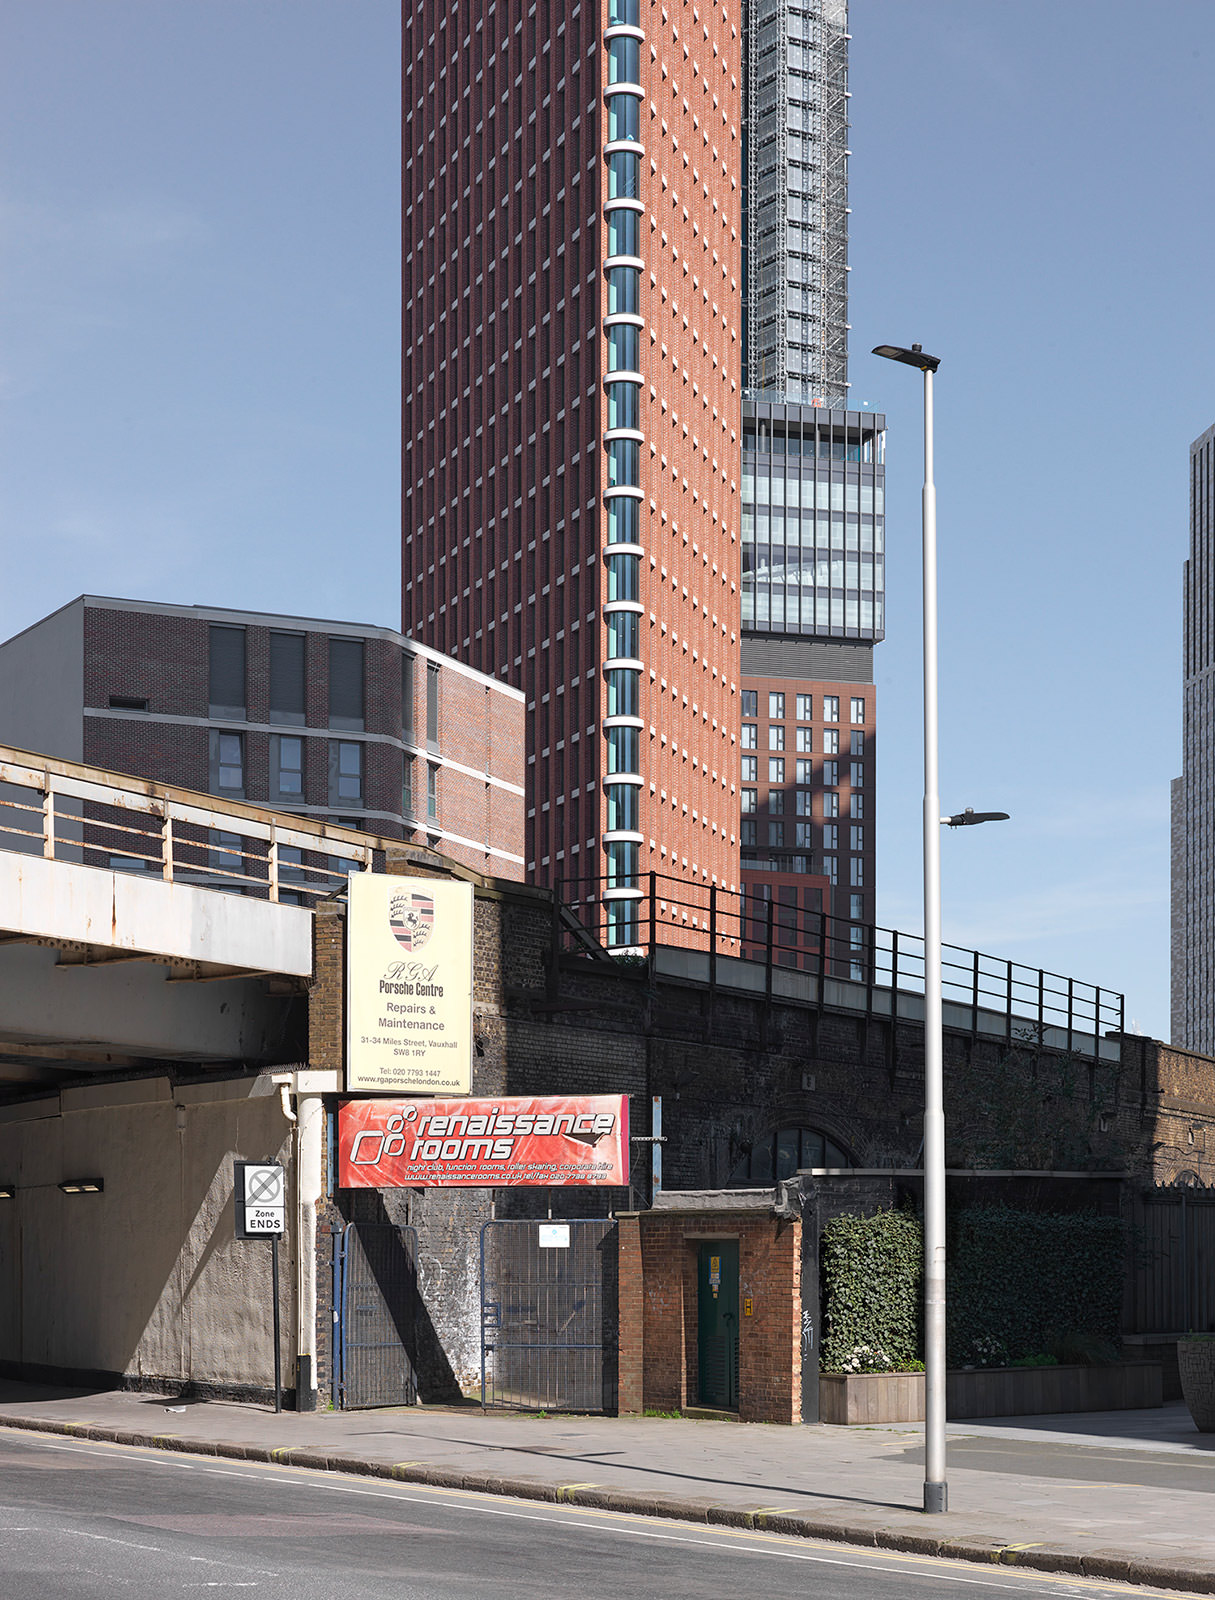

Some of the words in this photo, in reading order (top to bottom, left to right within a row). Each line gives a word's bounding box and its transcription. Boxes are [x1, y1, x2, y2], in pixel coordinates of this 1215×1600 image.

[383, 961, 439, 981] RGA
[379, 979, 414, 995] Porsche
[415, 982, 444, 997] Centre
[386, 1002, 427, 1015] Repairs
[428, 1005, 436, 1015] &
[378, 1017, 445, 1031] Maintenance
[360, 1036, 381, 1044] 31-34
[382, 1037, 402, 1046] Miles
[403, 1038, 427, 1048] Street,
[428, 1040, 458, 1049] Vauxhall
[393, 1048, 410, 1056] SW8
[379, 1067, 392, 1075] Tel:
[392, 1068, 406, 1076] 020
[357, 1076, 461, 1086] www.rgaporschelondon.co.uk
[417, 1108, 615, 1137] renaissance
[410, 1138, 515, 1161] rooms
[406, 1164, 427, 1173] night
[426, 1164, 444, 1172] club,
[445, 1163, 477, 1171] function
[479, 1163, 506, 1172] rooms,
[527, 1163, 558, 1172] skating,
[559, 1163, 596, 1172] corporate
[596, 1162, 614, 1170] hire
[250, 1219, 281, 1229] ENDS
